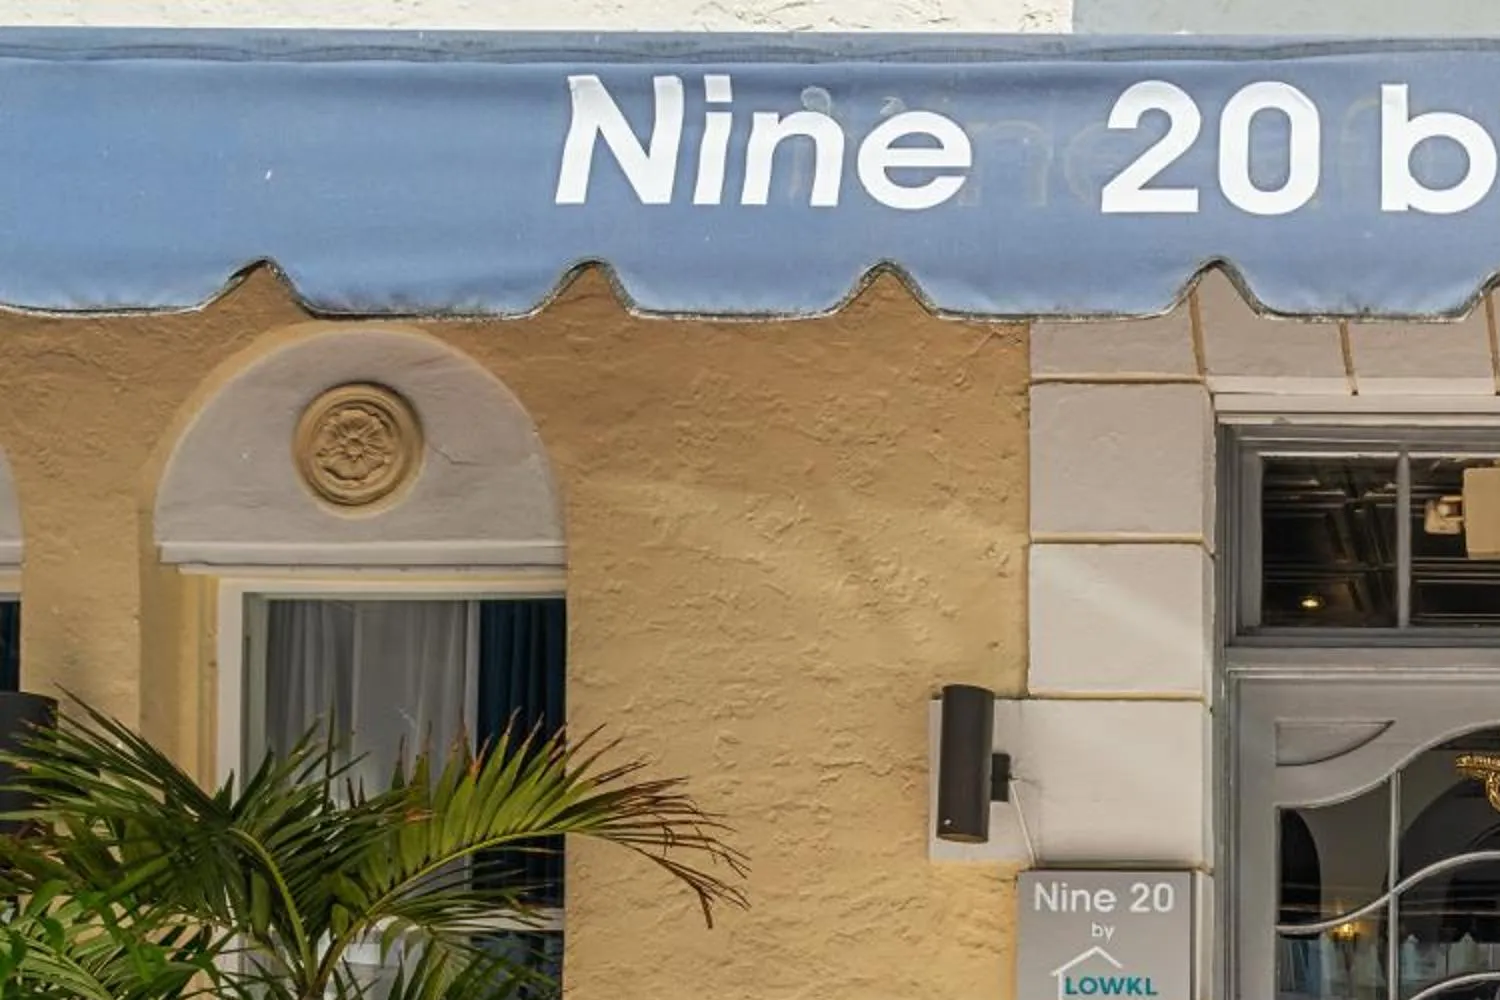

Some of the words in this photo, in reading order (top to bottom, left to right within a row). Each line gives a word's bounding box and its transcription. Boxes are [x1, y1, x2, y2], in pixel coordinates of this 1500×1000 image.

[554, 74, 973, 210] Nine
[1100, 80, 1322, 216] 20
[1034, 882, 1117, 912] Nine
[1129, 883, 1174, 912] 20
[1091, 922, 1114, 943] by
[1064, 976, 1158, 996] LOWKL
